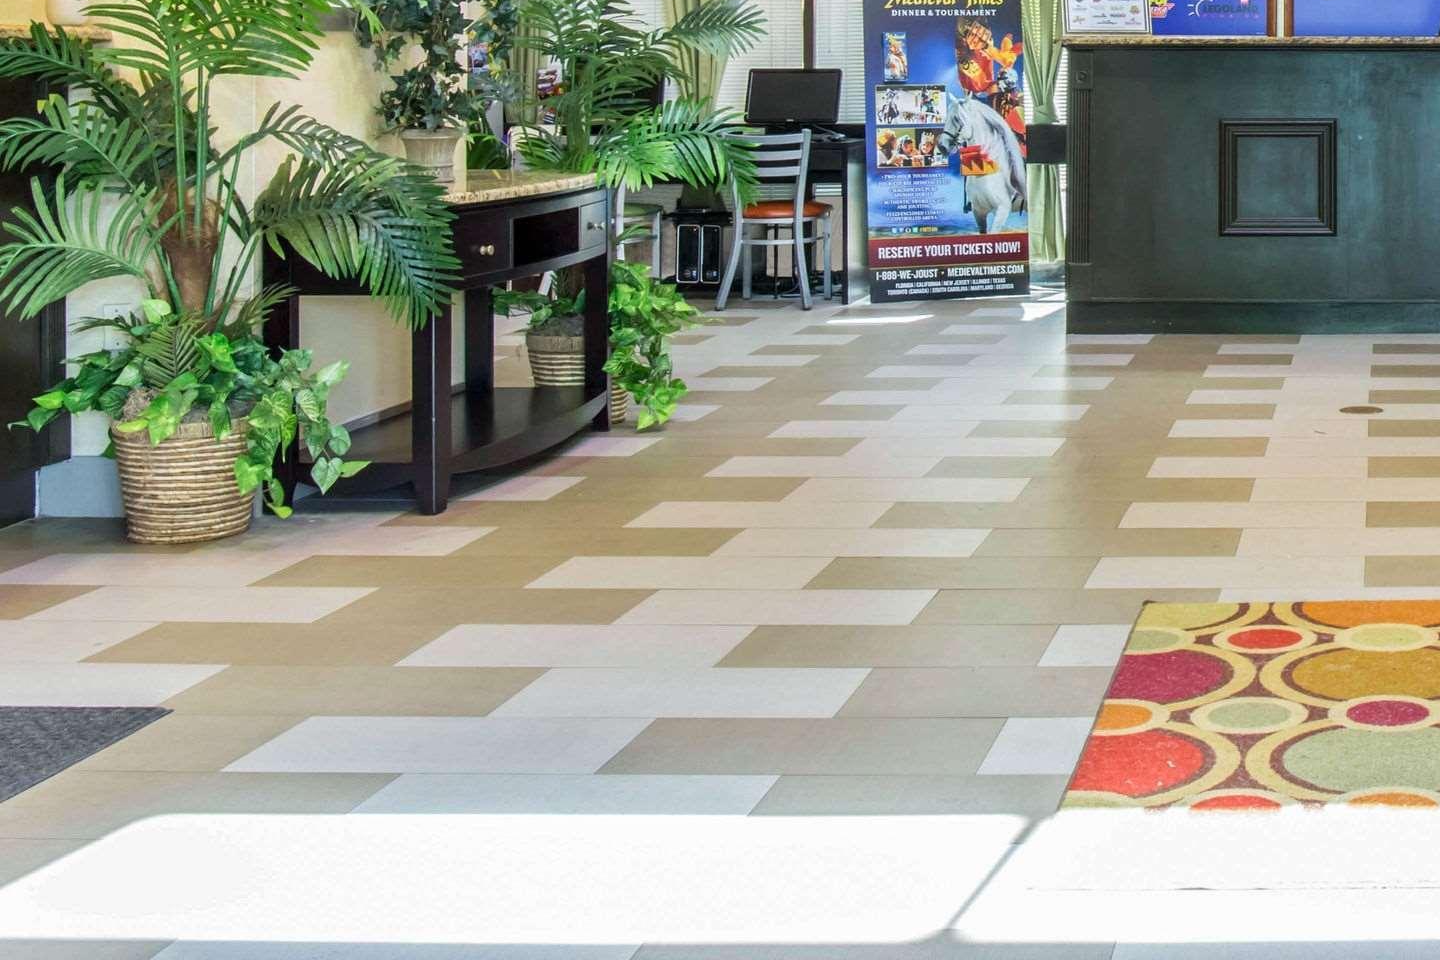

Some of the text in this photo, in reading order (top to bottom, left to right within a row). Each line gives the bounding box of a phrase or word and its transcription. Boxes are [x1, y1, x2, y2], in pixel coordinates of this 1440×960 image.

[892, 9, 997, 17] DINNER & TOURNAMENT
[1203, 3, 1259, 13] LEGOLAND
[878, 241, 1021, 259] RESERVE YOUR TICKETS NOW!
[947, 265, 1024, 277] MEDIEVALTIMES.COM
